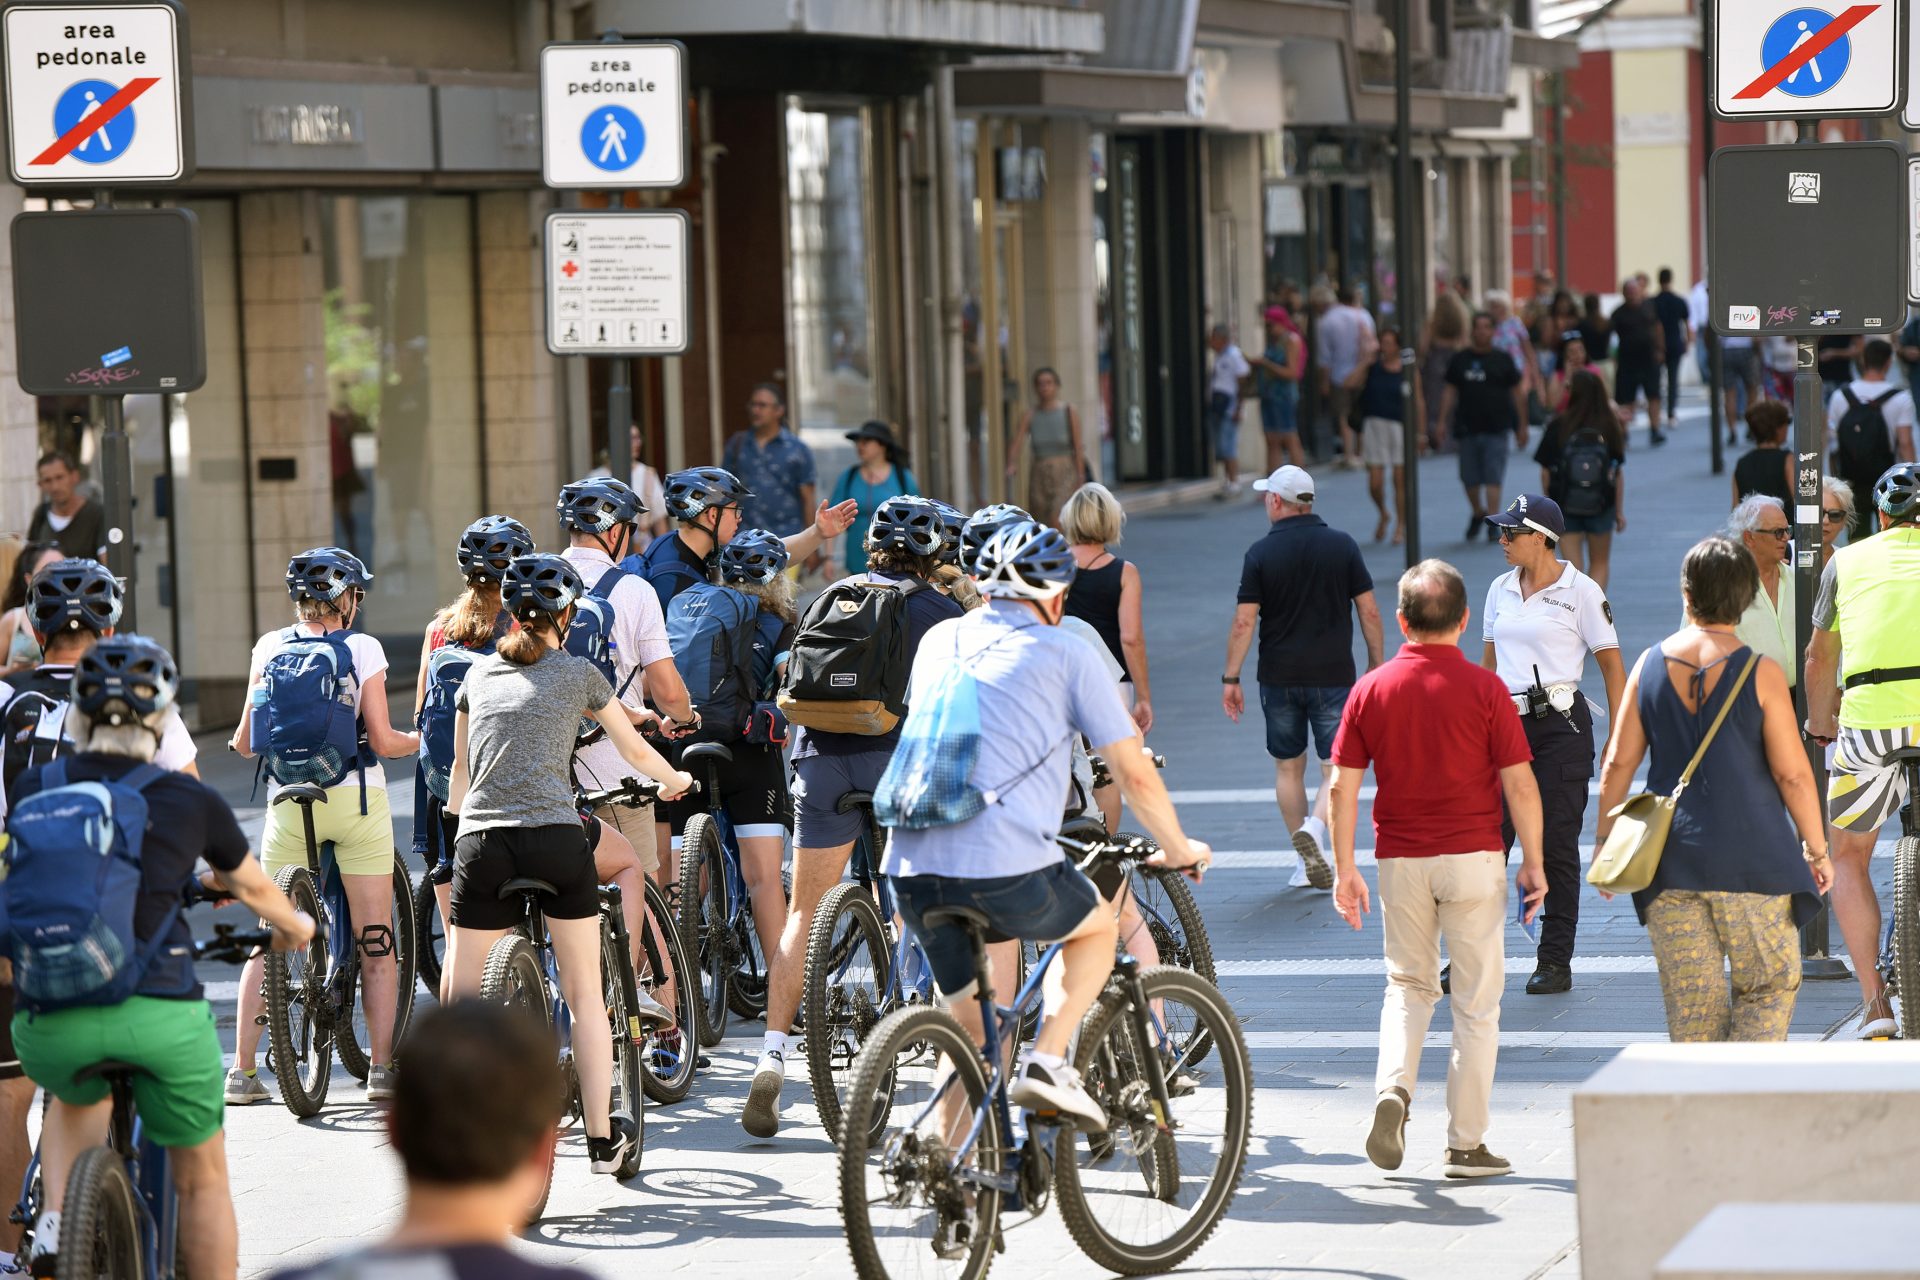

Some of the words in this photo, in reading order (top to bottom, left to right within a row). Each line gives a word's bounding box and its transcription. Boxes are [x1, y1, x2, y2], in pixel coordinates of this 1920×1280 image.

[64, 25, 115, 38] area
[37, 47, 146, 69] pedonale
[590, 60, 631, 72] area
[568, 78, 655, 96] pedonale
[1733, 313, 1749, 321] FIV
[1542, 596, 1560, 606] POLIZIA
[1559, 601, 1576, 613] LOCALE
